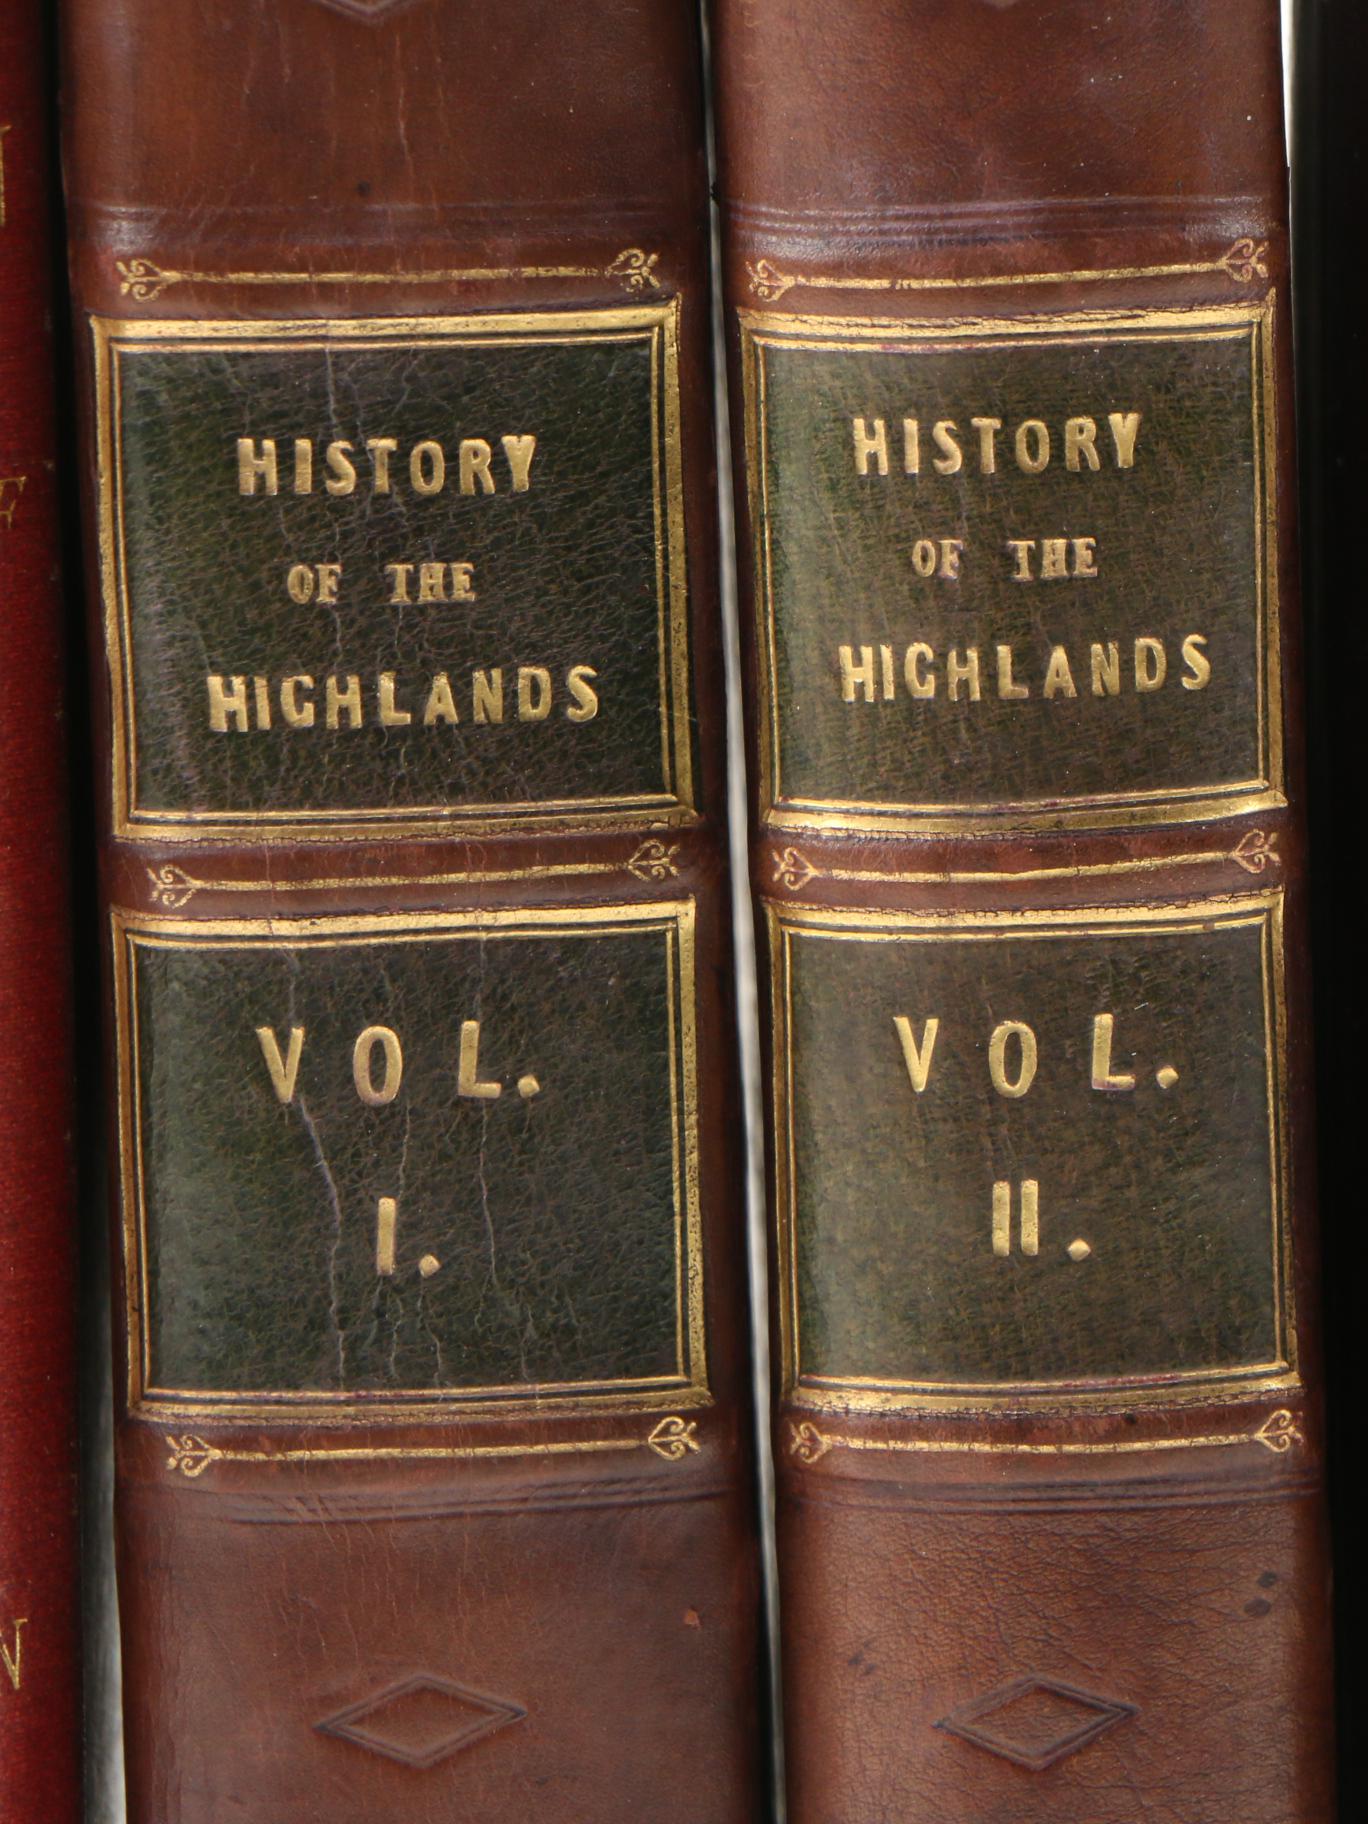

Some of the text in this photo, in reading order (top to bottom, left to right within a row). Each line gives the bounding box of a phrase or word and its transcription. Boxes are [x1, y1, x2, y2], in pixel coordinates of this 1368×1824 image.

[237, 434, 537, 496] HISTORY
[851, 411, 1141, 476] HISTORY
[286, 561, 476, 605] OF THE
[911, 536, 1098, 582] OF THE
[206, 664, 599, 733] HIGHLANDS
[837, 632, 1212, 703] HIGHLANDS
[255, 1019, 541, 1105] VOL.
[892, 1012, 1179, 1099] VOL.
[376, 1196, 441, 1277] I.
[991, 1177, 1092, 1261] II.
